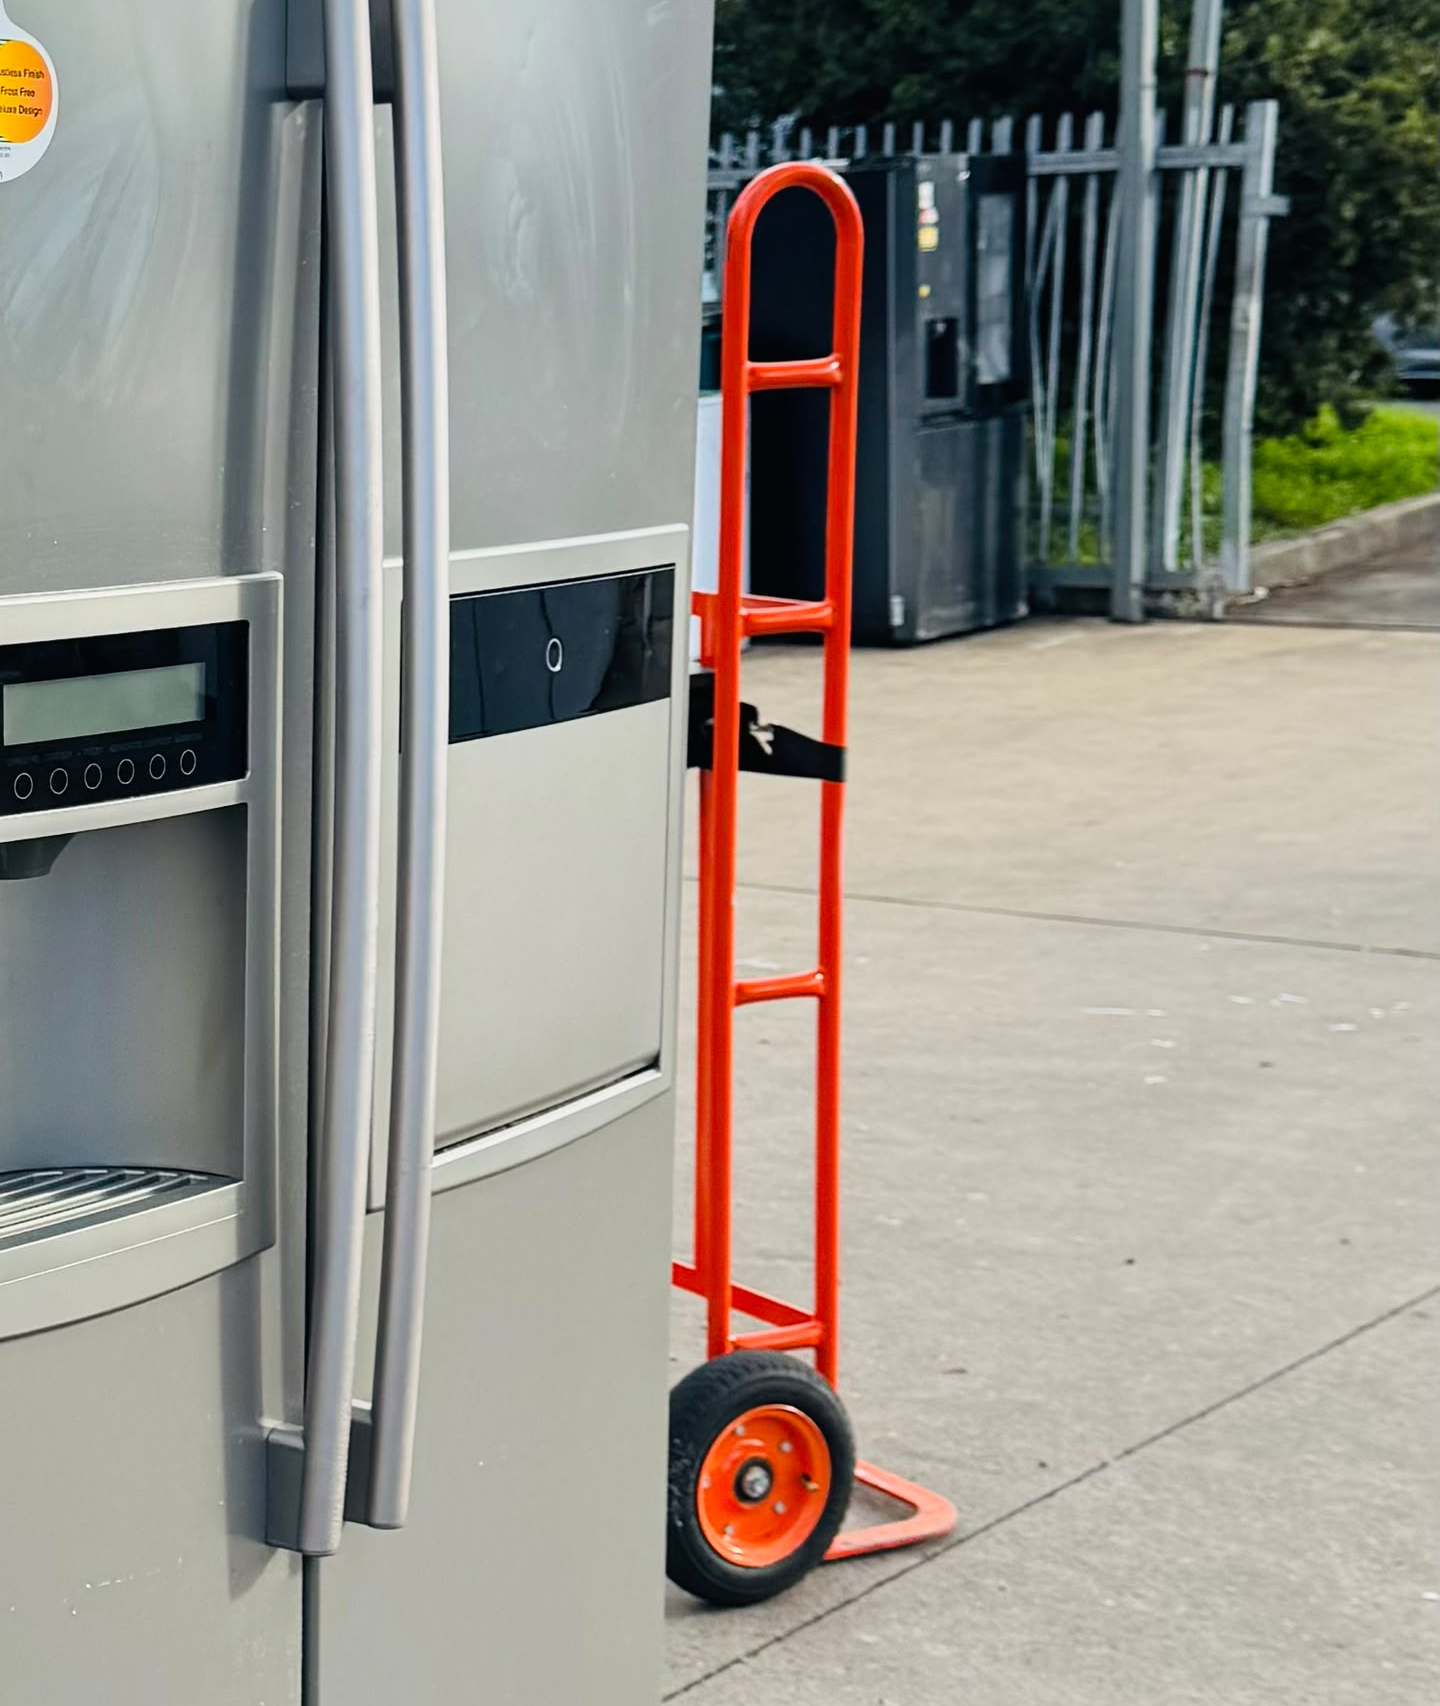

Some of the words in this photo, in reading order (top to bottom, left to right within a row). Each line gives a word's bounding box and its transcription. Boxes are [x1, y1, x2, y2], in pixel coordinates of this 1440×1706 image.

[23, 68, 45, 79] Finish
[0, 86, 19, 96] Frost
[19, 87, 36, 98] Free
[18, 104, 43, 118] Design
